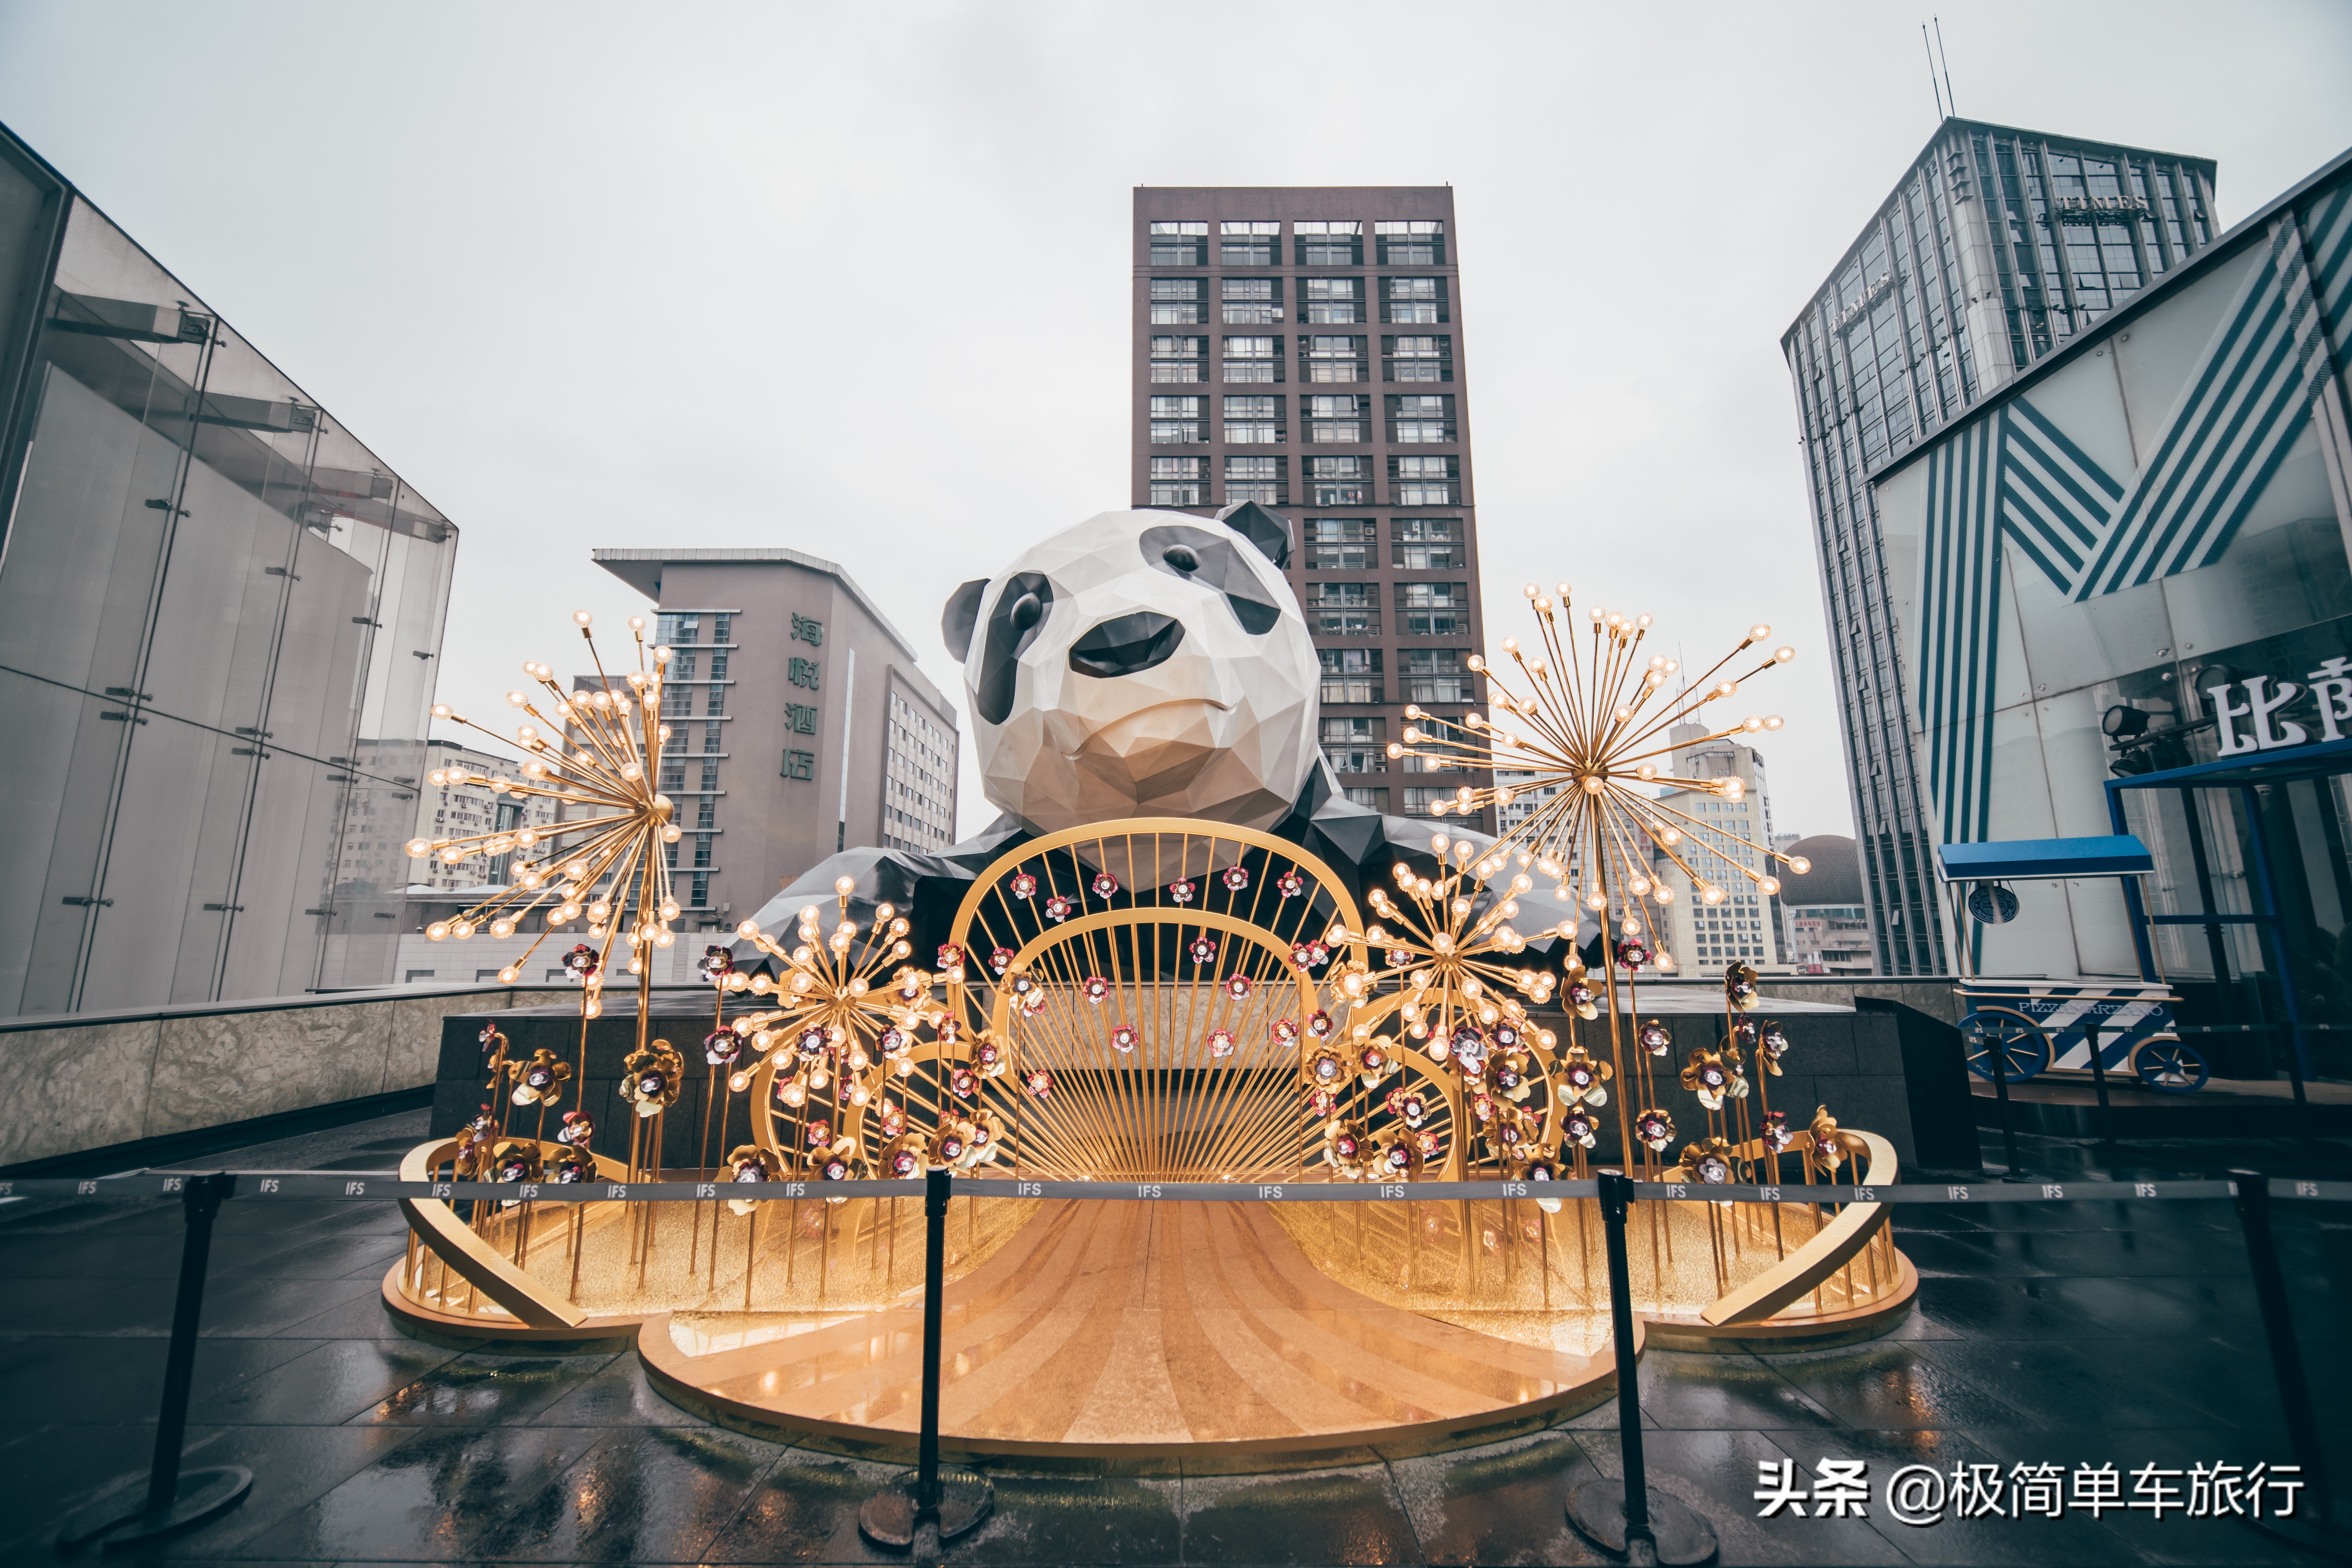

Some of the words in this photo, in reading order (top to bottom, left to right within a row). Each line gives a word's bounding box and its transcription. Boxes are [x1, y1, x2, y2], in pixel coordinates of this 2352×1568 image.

[2058, 195, 2148, 210] TIMES
[1829, 269, 1893, 333] TIMES
[780, 611, 822, 781] 海悦酒店
[78, 1181, 97, 1194] IFS
[163, 1178, 182, 1191] IFS
[260, 1179, 279, 1192] IFS
[346, 1182, 365, 1195] IFS
[432, 1184, 451, 1197] IFS
[520, 1184, 538, 1198] IFS
[607, 1185, 626, 1198] IFS
[697, 1184, 715, 1197] IFS
[786, 1183, 805, 1196] IFS
[1018, 1183, 1041, 1195] IFS
[1138, 1185, 1161, 1198] IFS
[1259, 1186, 1282, 1198] IFS
[1381, 1185, 1405, 1198] IFS
[1502, 1183, 1527, 1196] IFS
[1666, 1184, 1686, 1198] IFS
[1760, 1187, 1780, 1201] IFS
[1854, 1188, 1875, 1201] IFS
[1948, 1186, 1969, 1200] IFS
[2042, 1185, 2062, 1199] IFS
[2134, 1183, 2157, 1197] IFS
[2295, 1181, 2319, 1197] IFS
